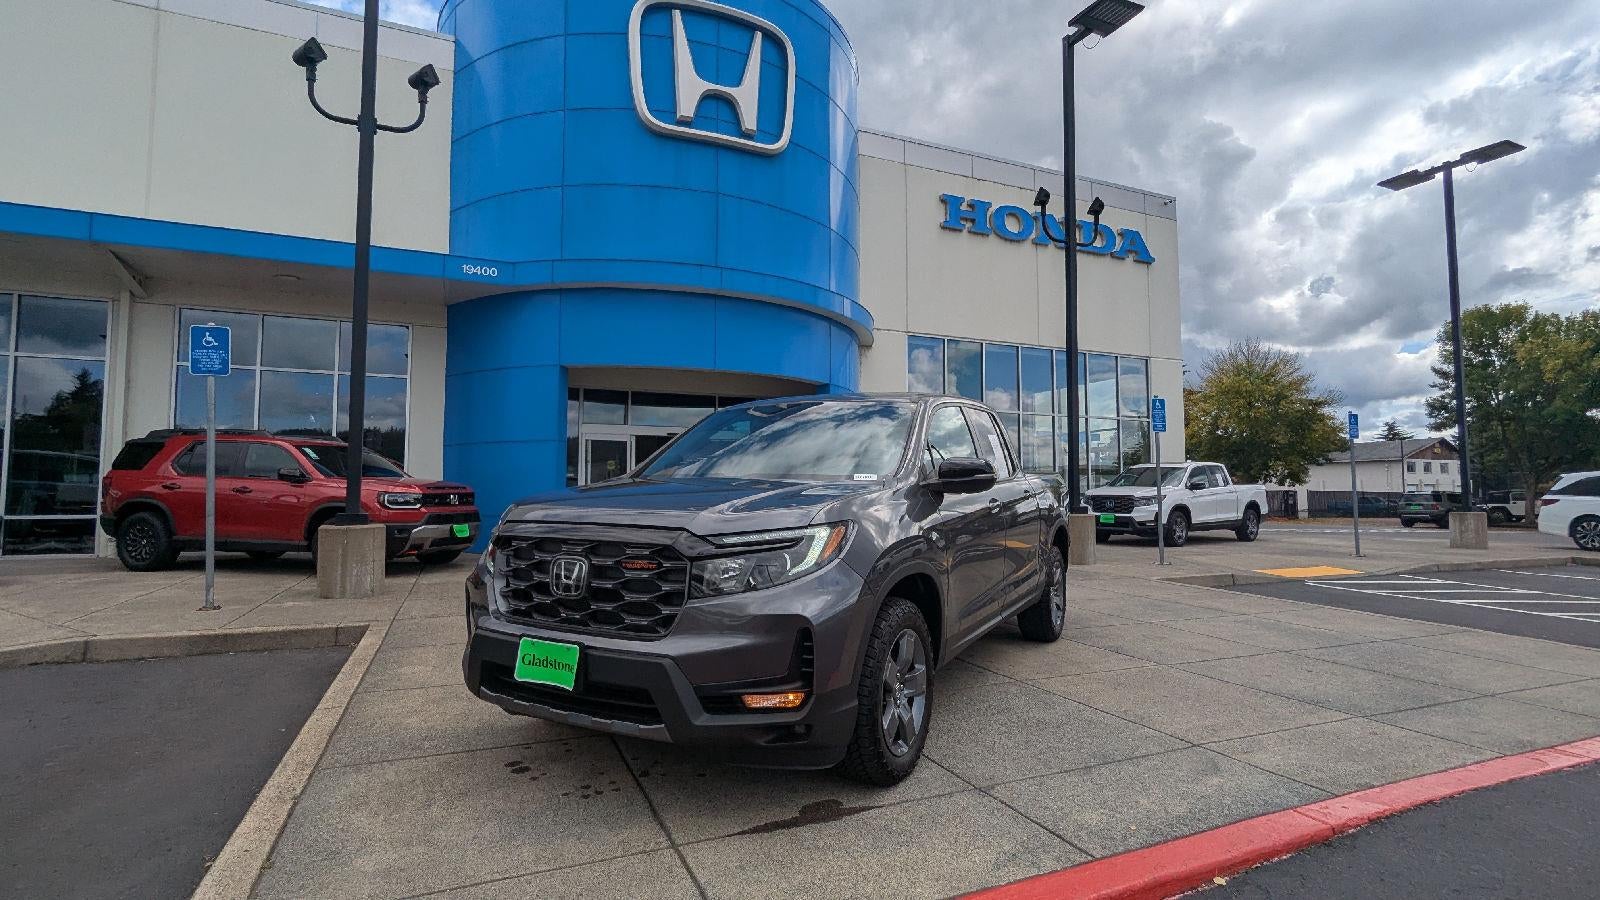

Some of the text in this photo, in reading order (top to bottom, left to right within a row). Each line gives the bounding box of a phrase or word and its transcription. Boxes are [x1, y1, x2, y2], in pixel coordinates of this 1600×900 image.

[939, 193, 1155, 263] HONDA
[461, 264, 498, 277] 19400
[521, 652, 575, 674] Gladstone
